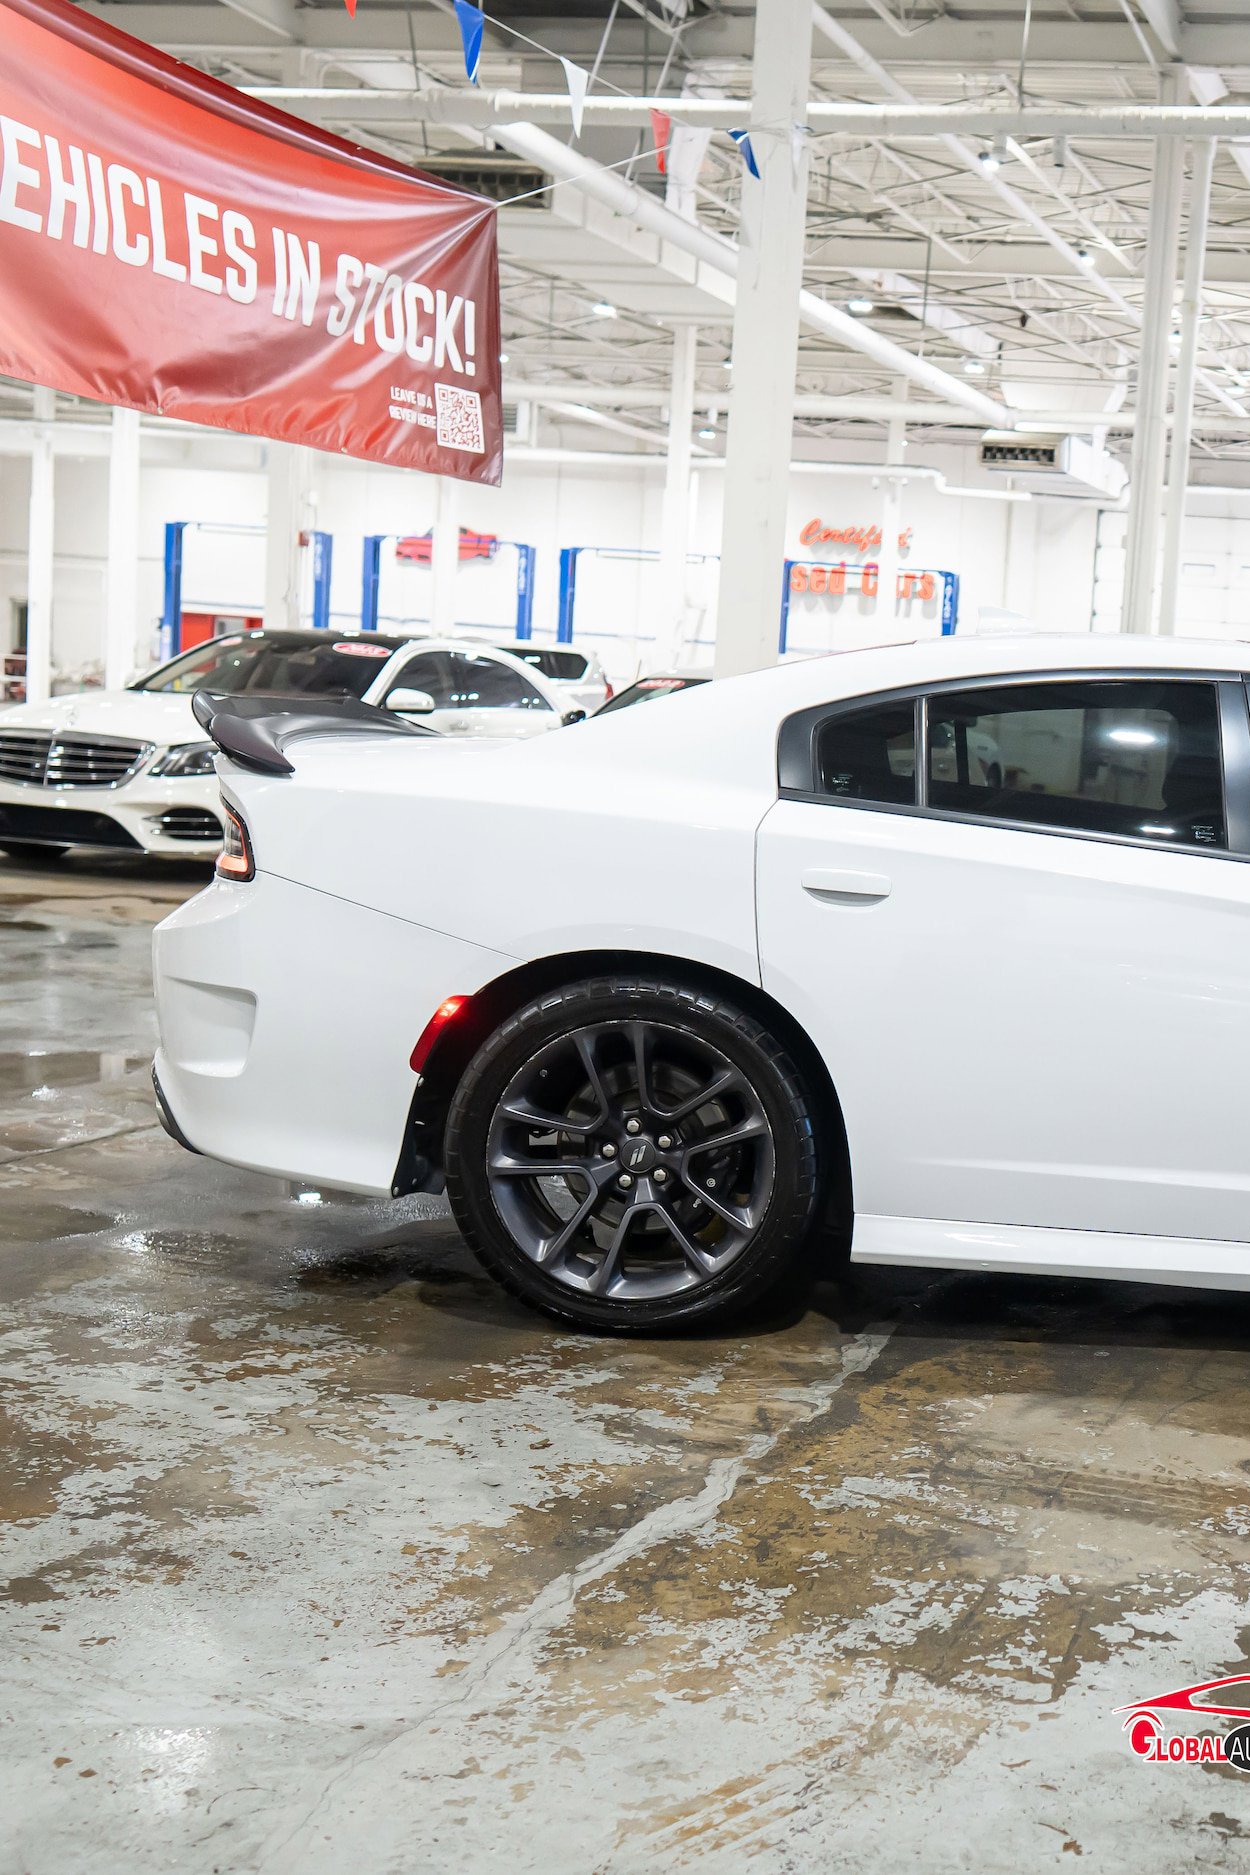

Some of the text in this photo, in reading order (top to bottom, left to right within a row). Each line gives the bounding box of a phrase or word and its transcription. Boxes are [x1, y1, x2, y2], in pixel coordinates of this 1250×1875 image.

[272, 227, 320, 327] IN
[328, 254, 476, 376] STOCK!
[390, 386, 416, 405] LEAVE
[427, 396, 433, 409] A
[861, 562, 936, 600] Crs
